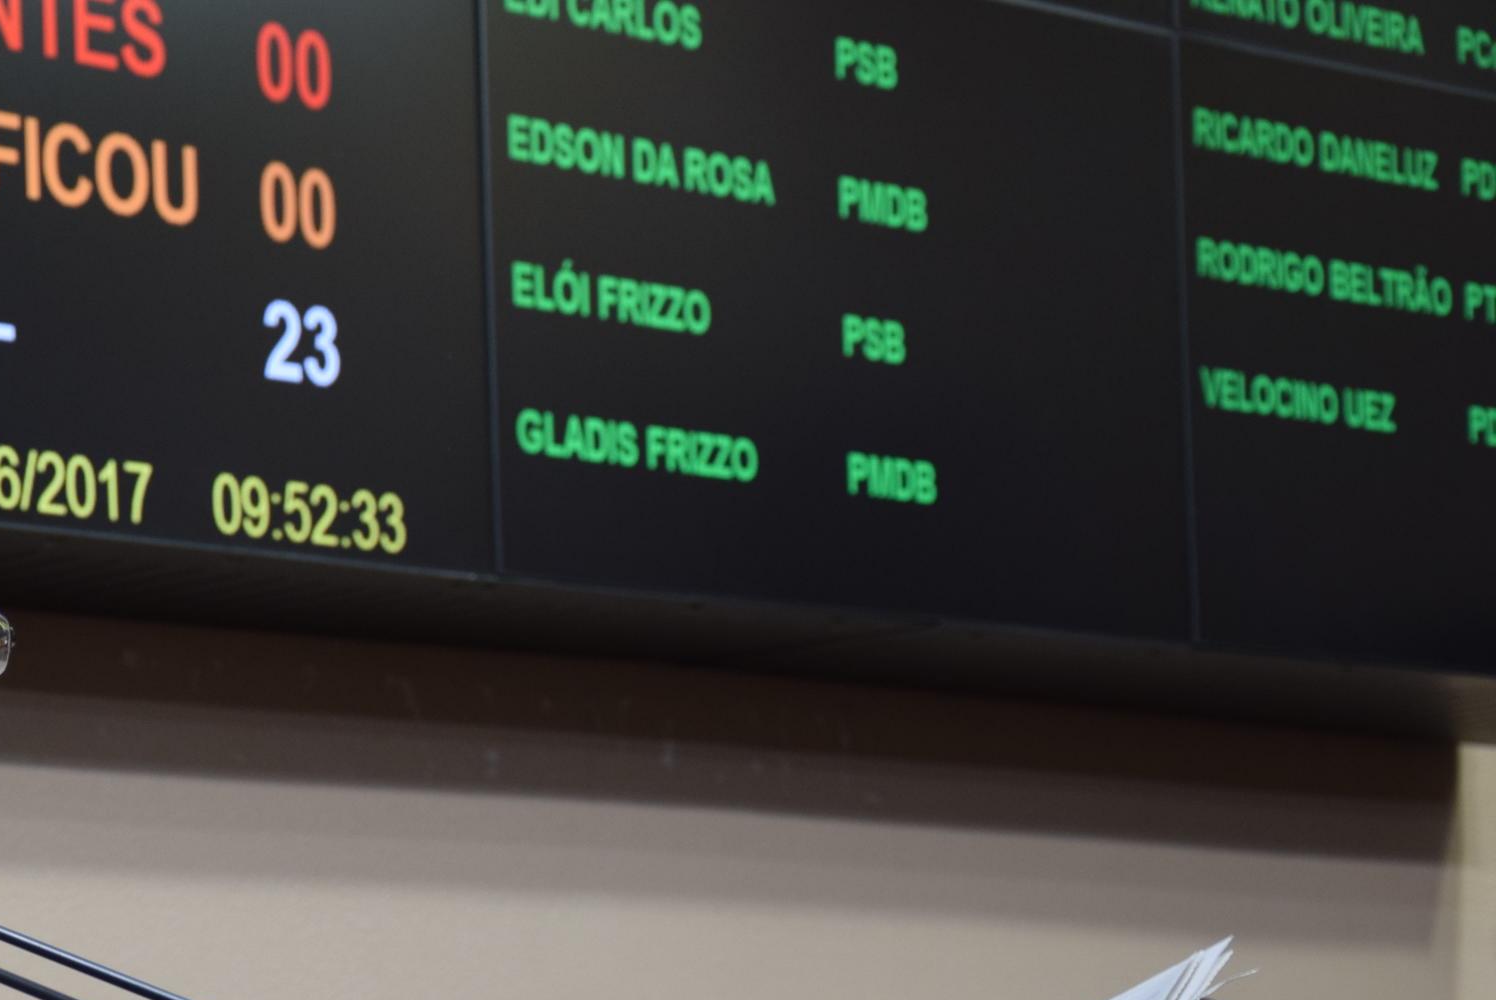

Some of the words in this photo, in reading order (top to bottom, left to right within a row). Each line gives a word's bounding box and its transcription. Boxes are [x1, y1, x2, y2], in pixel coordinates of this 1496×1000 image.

[255, 21, 333, 110] 00
[834, 36, 898, 90] PSB
[1304, 0, 1424, 54] OLIVEIRA
[507, 113, 626, 179] EDSON
[631, 136, 680, 189] DA
[682, 146, 776, 206] ROSA
[836, 175, 929, 232] PMDB
[1192, 107, 1315, 167] RICARDO
[1317, 131, 1439, 191] DANELUZ
[259, 160, 337, 249] 00
[510, 258, 591, 317] ELÓI
[596, 274, 712, 335] FRIZZO
[841, 313, 907, 365] PSB
[1196, 237, 1325, 296] RODRIGO
[1328, 258, 1453, 316] BELTRÃO
[263, 299, 341, 388] 23
[1200, 367, 1339, 425] VELOCINO
[1342, 388, 1397, 433] UEZ
[515, 408, 640, 468] GLADIS
[644, 424, 760, 483] FRIZZO
[845, 451, 938, 505] PMDB
[212, 472, 407, 555] 09:52:33
